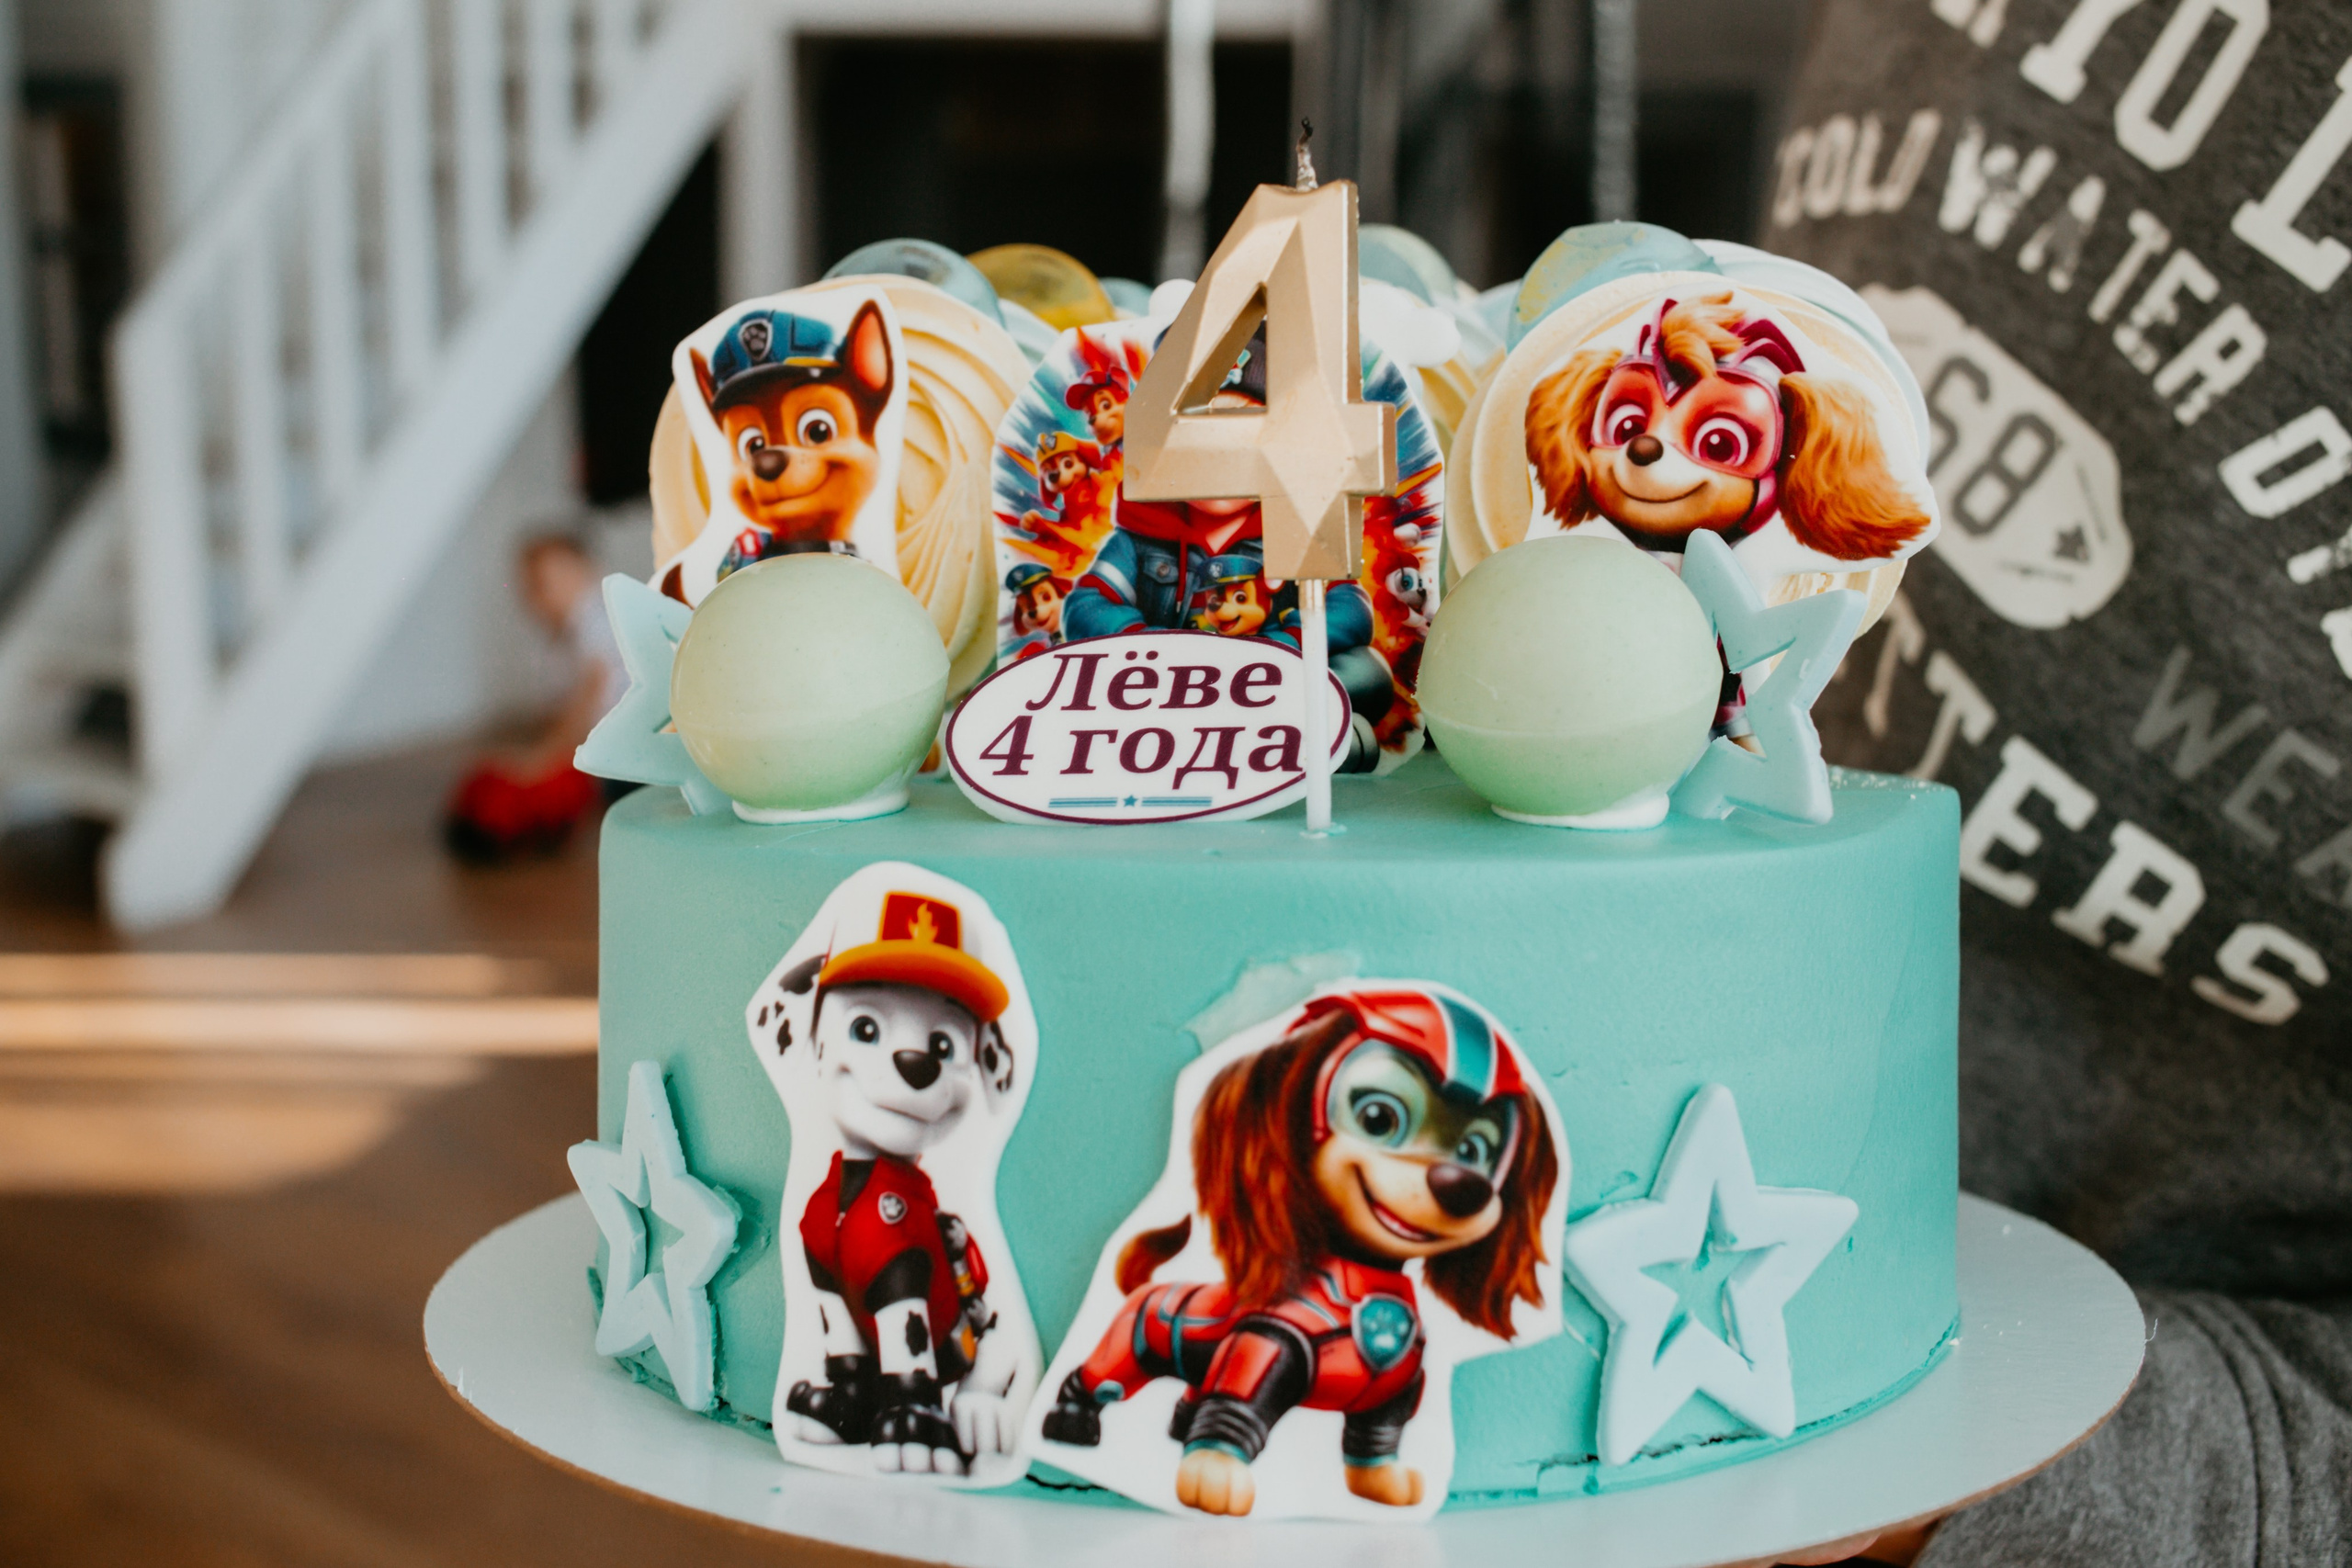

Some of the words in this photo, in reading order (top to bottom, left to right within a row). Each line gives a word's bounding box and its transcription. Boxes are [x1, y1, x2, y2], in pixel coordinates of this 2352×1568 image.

[1933, 0, 2271, 172] YO
[1123, 179, 1397, 581] 4
[1937, 115, 2267, 426] WATER
[978, 715, 1035, 776] 4
[1058, 724, 1304, 791] года
[1025, 650, 1283, 712] Лёве
[1836, 588, 2330, 1026] TTERS
